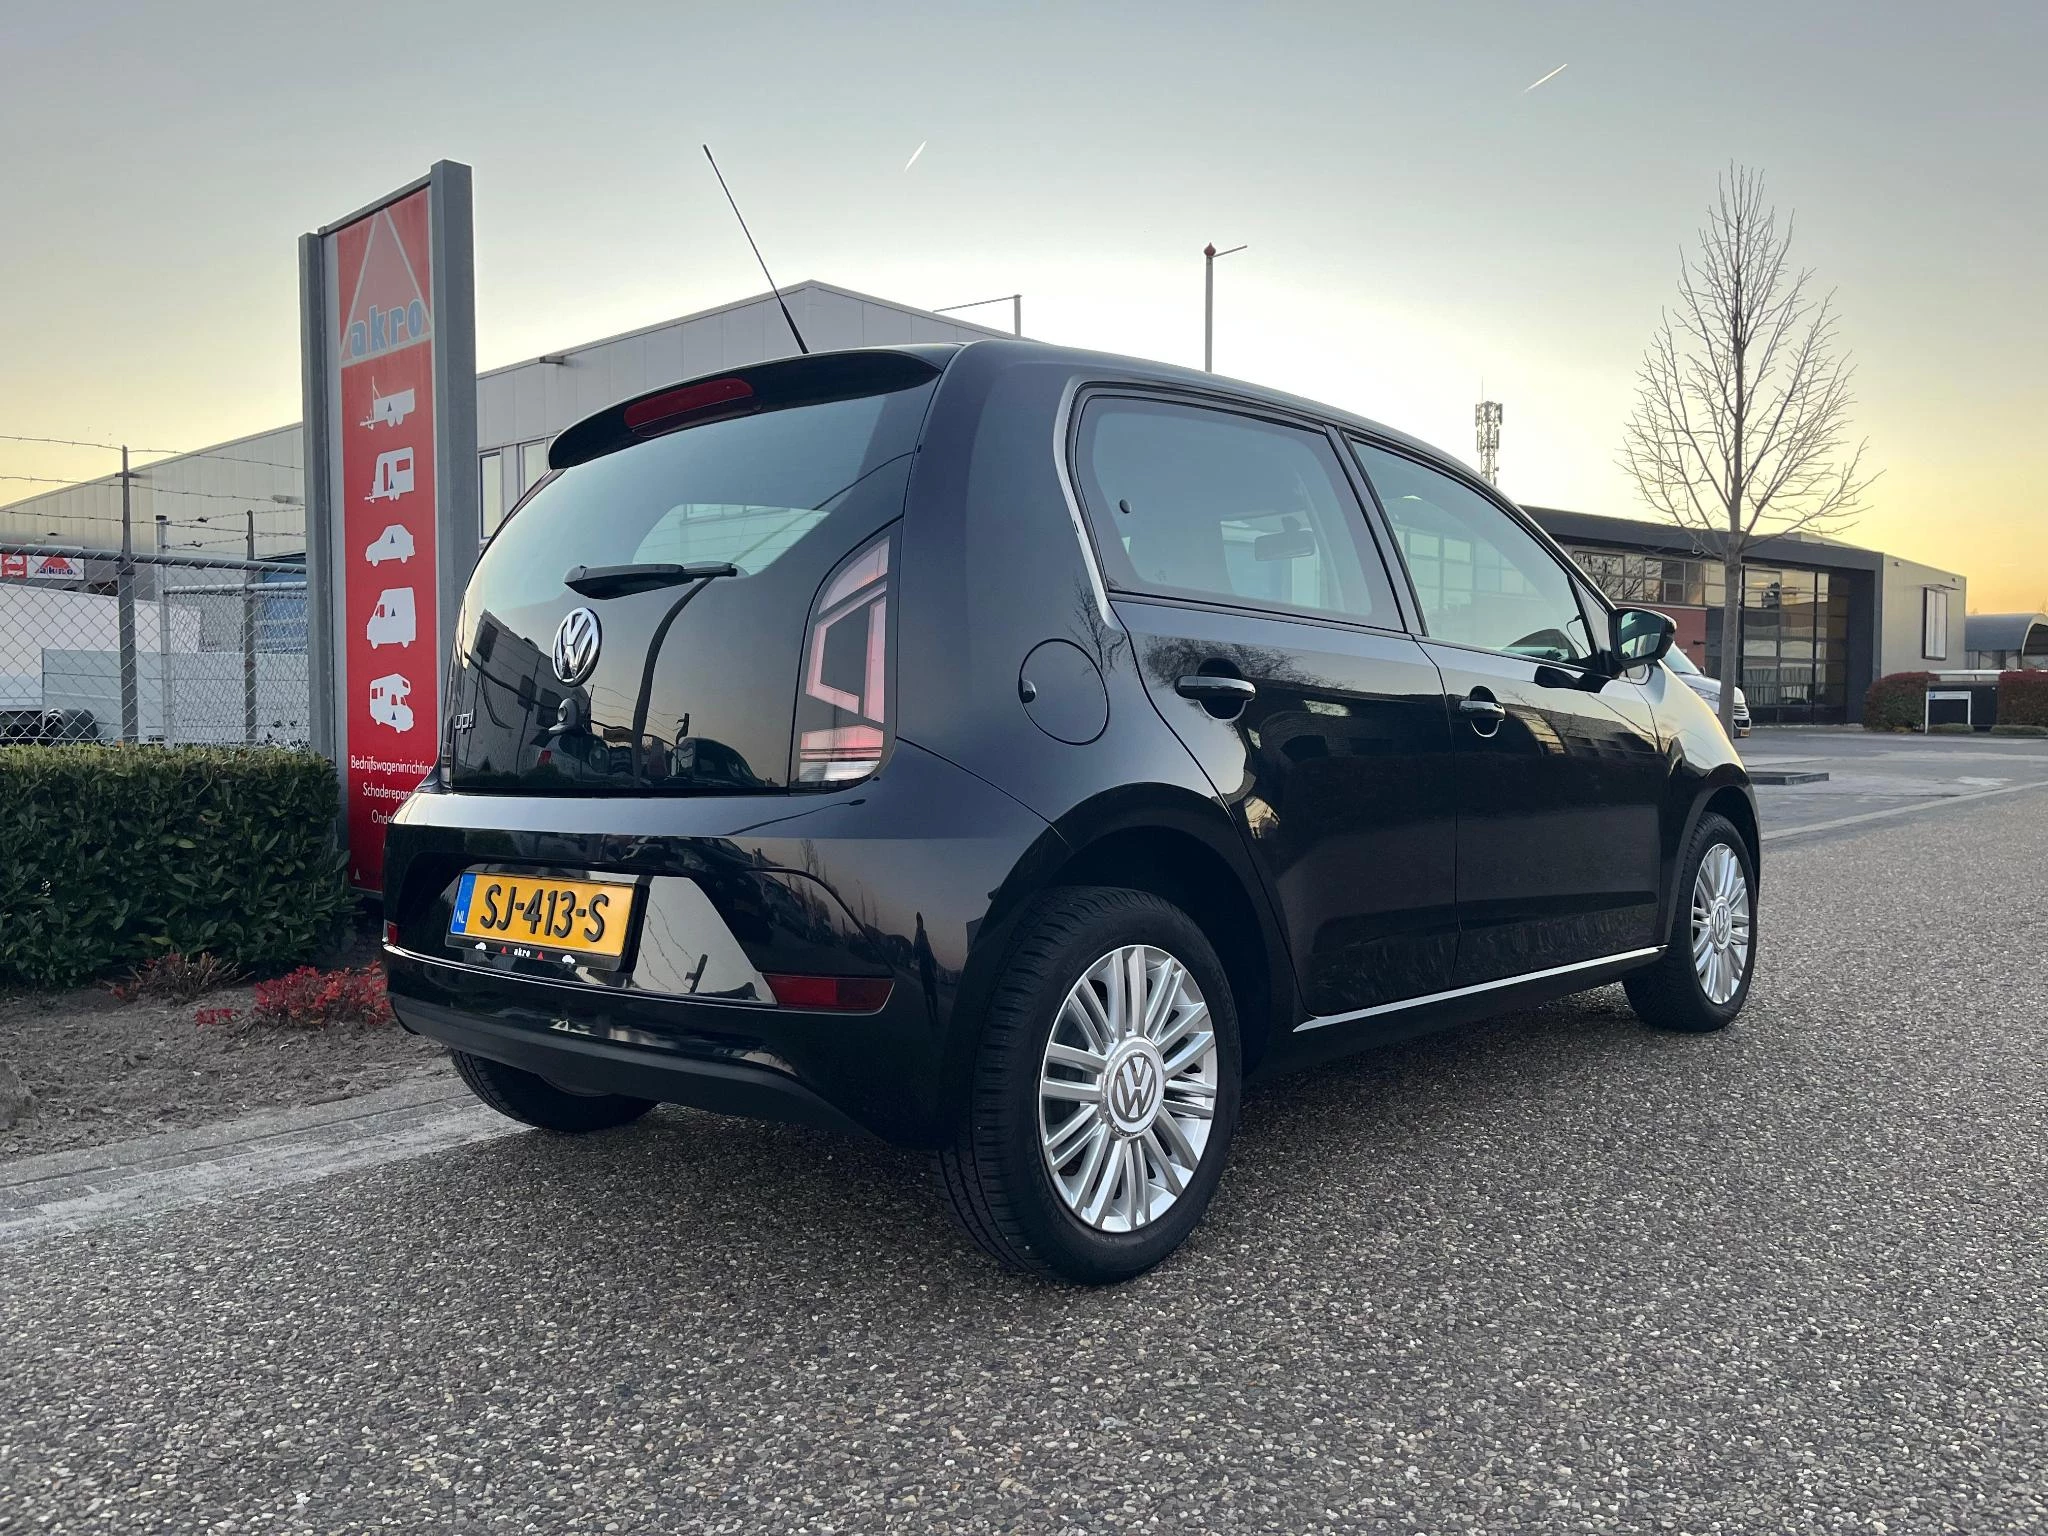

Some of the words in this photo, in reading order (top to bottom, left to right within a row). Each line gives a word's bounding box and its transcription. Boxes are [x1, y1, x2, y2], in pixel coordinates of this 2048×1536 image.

[350, 298, 424, 358] akro
[455, 909, 465, 924] NL
[480, 884, 609, 942] SJ-413-S
[513, 947, 531, 958] akro
